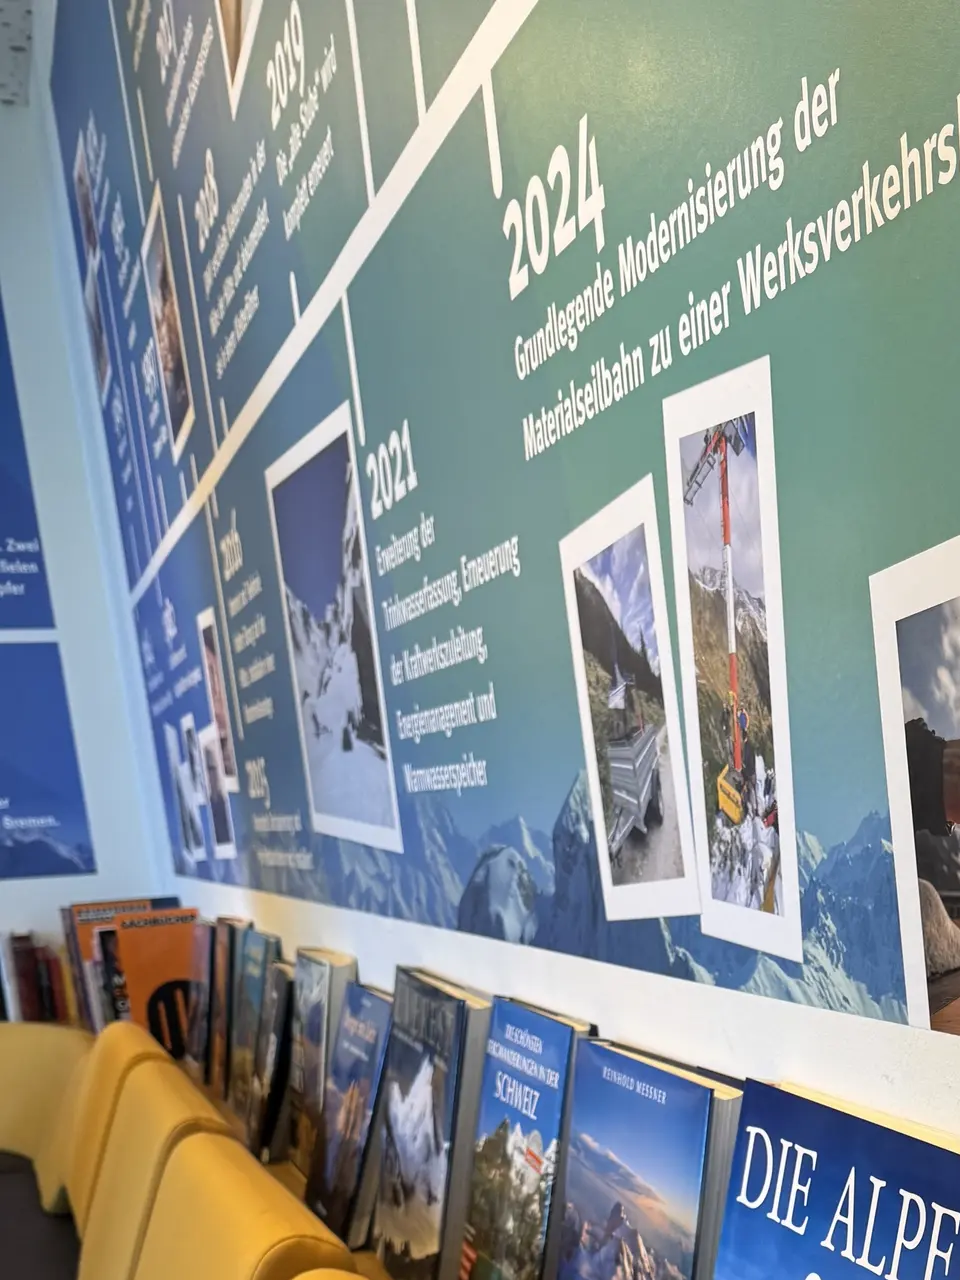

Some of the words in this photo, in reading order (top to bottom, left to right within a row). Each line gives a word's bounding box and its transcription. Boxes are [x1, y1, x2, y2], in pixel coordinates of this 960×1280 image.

[266, 0, 305, 131] 2019
[194, 148, 219, 254] 2018
[502, 113, 605, 300] 2024
[513, 261, 614, 381] Grundlegende
[618, 116, 785, 297] Modernisierung
[793, 67, 841, 153] der
[522, 342, 645, 461] Materialseilbahn
[648, 323, 673, 377] zu
[678, 280, 731, 357] einer
[366, 418, 418, 520] 2021
[375, 526, 421, 577] Erweiterung
[420, 511, 435, 548] der
[381, 570, 462, 631] Trinkwasserfassung,
[460, 535, 521, 592] Erneuerung
[390, 654, 404, 686] der
[403, 625, 488, 681] Kraftwerkszuleitung,
[396, 692, 477, 744] Energiemanagement
[476, 681, 497, 722] und
[403, 752, 488, 797] Warmwasserspeicher
[494, 1070, 540, 1121] SCHWEIZ
[545, 1067, 560, 1090] DER
[602, 1065, 635, 1091] REINHOLD
[635, 1080, 667, 1106] MESSNER
[736, 1125, 818, 1236] DIE
